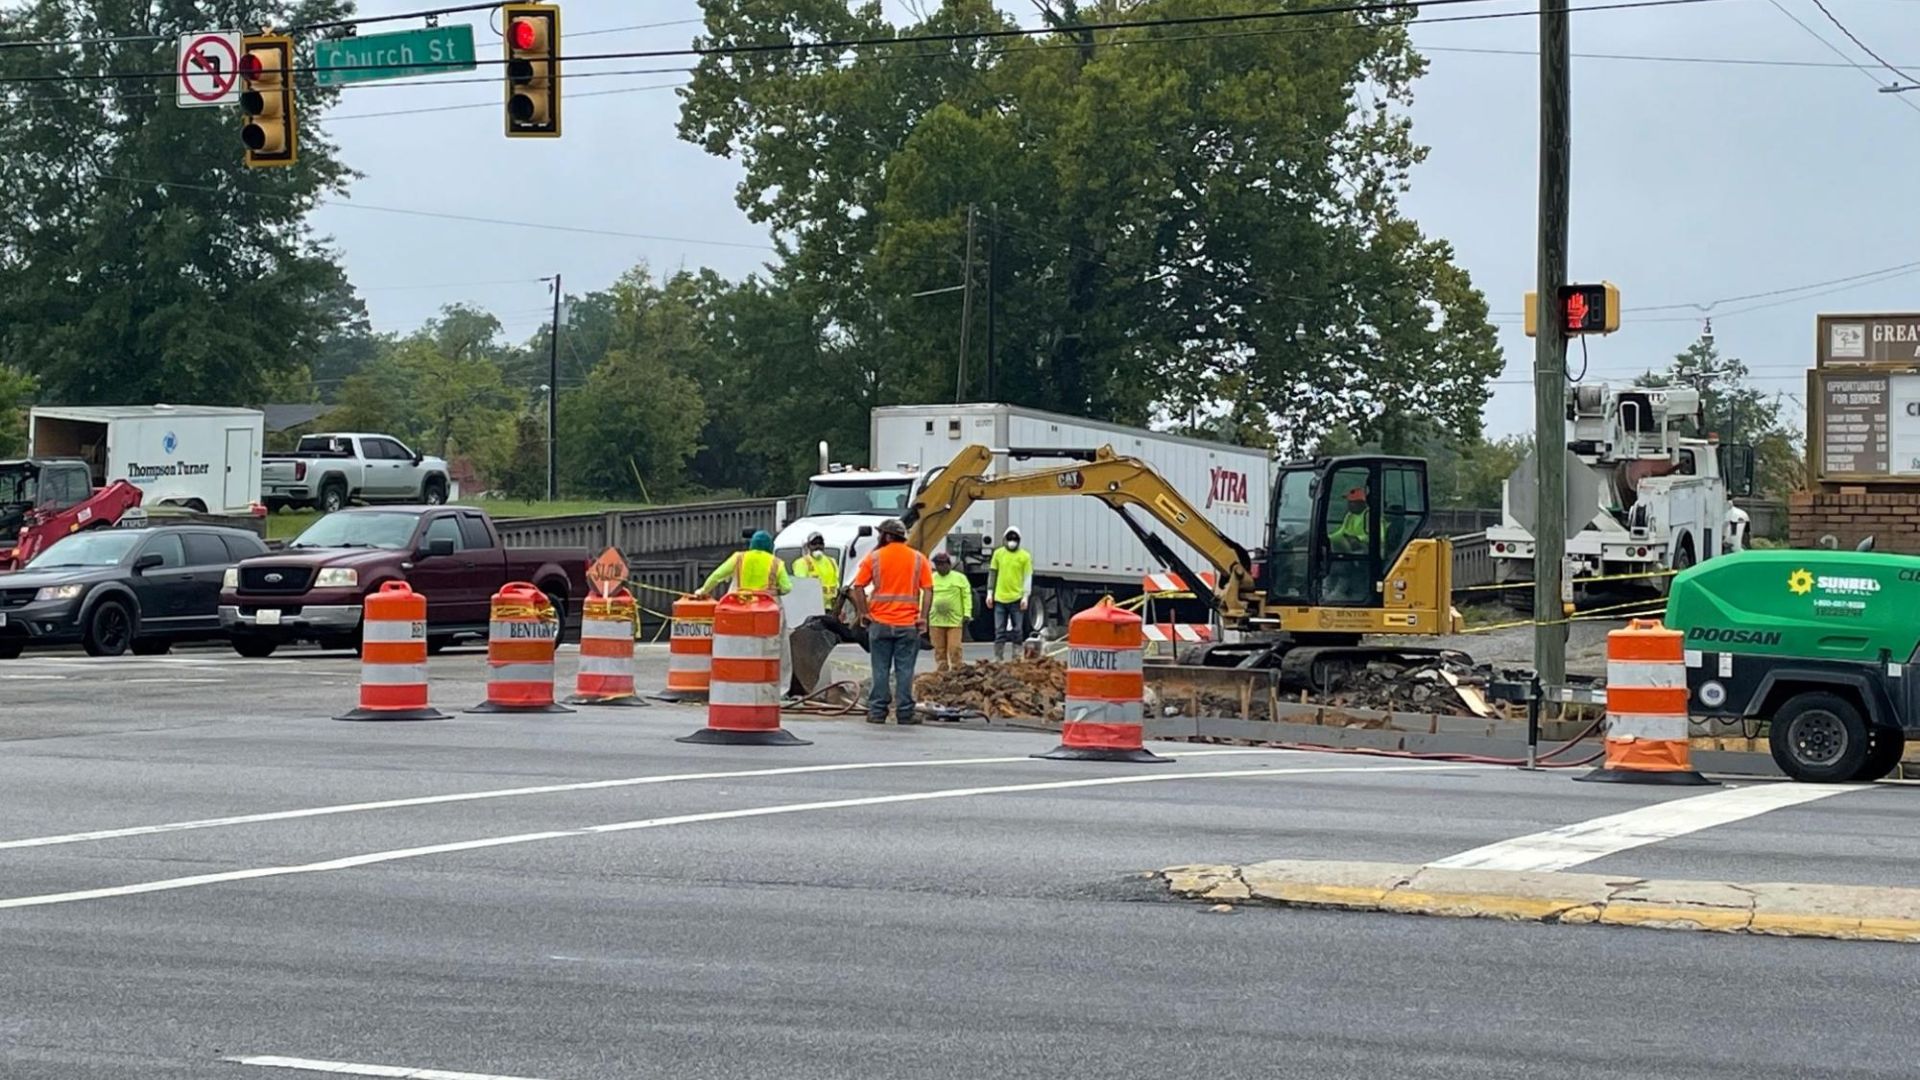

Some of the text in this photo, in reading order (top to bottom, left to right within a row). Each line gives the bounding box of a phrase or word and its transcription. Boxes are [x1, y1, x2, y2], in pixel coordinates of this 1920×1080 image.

[329, 37, 456, 68] Church St
[1872, 323, 1920, 342] GREA
[1827, 380, 1886, 392] OPPORTUNITIES
[1832, 393, 1881, 405] FOR SERVICE
[128, 460, 209, 480] Thompson Turner
[1058, 470, 1079, 487] CAT
[1206, 466, 1248, 509] XTRA
[1687, 626, 1783, 646] DOOSAN
[1070, 648, 1118, 671] CONCRETE
